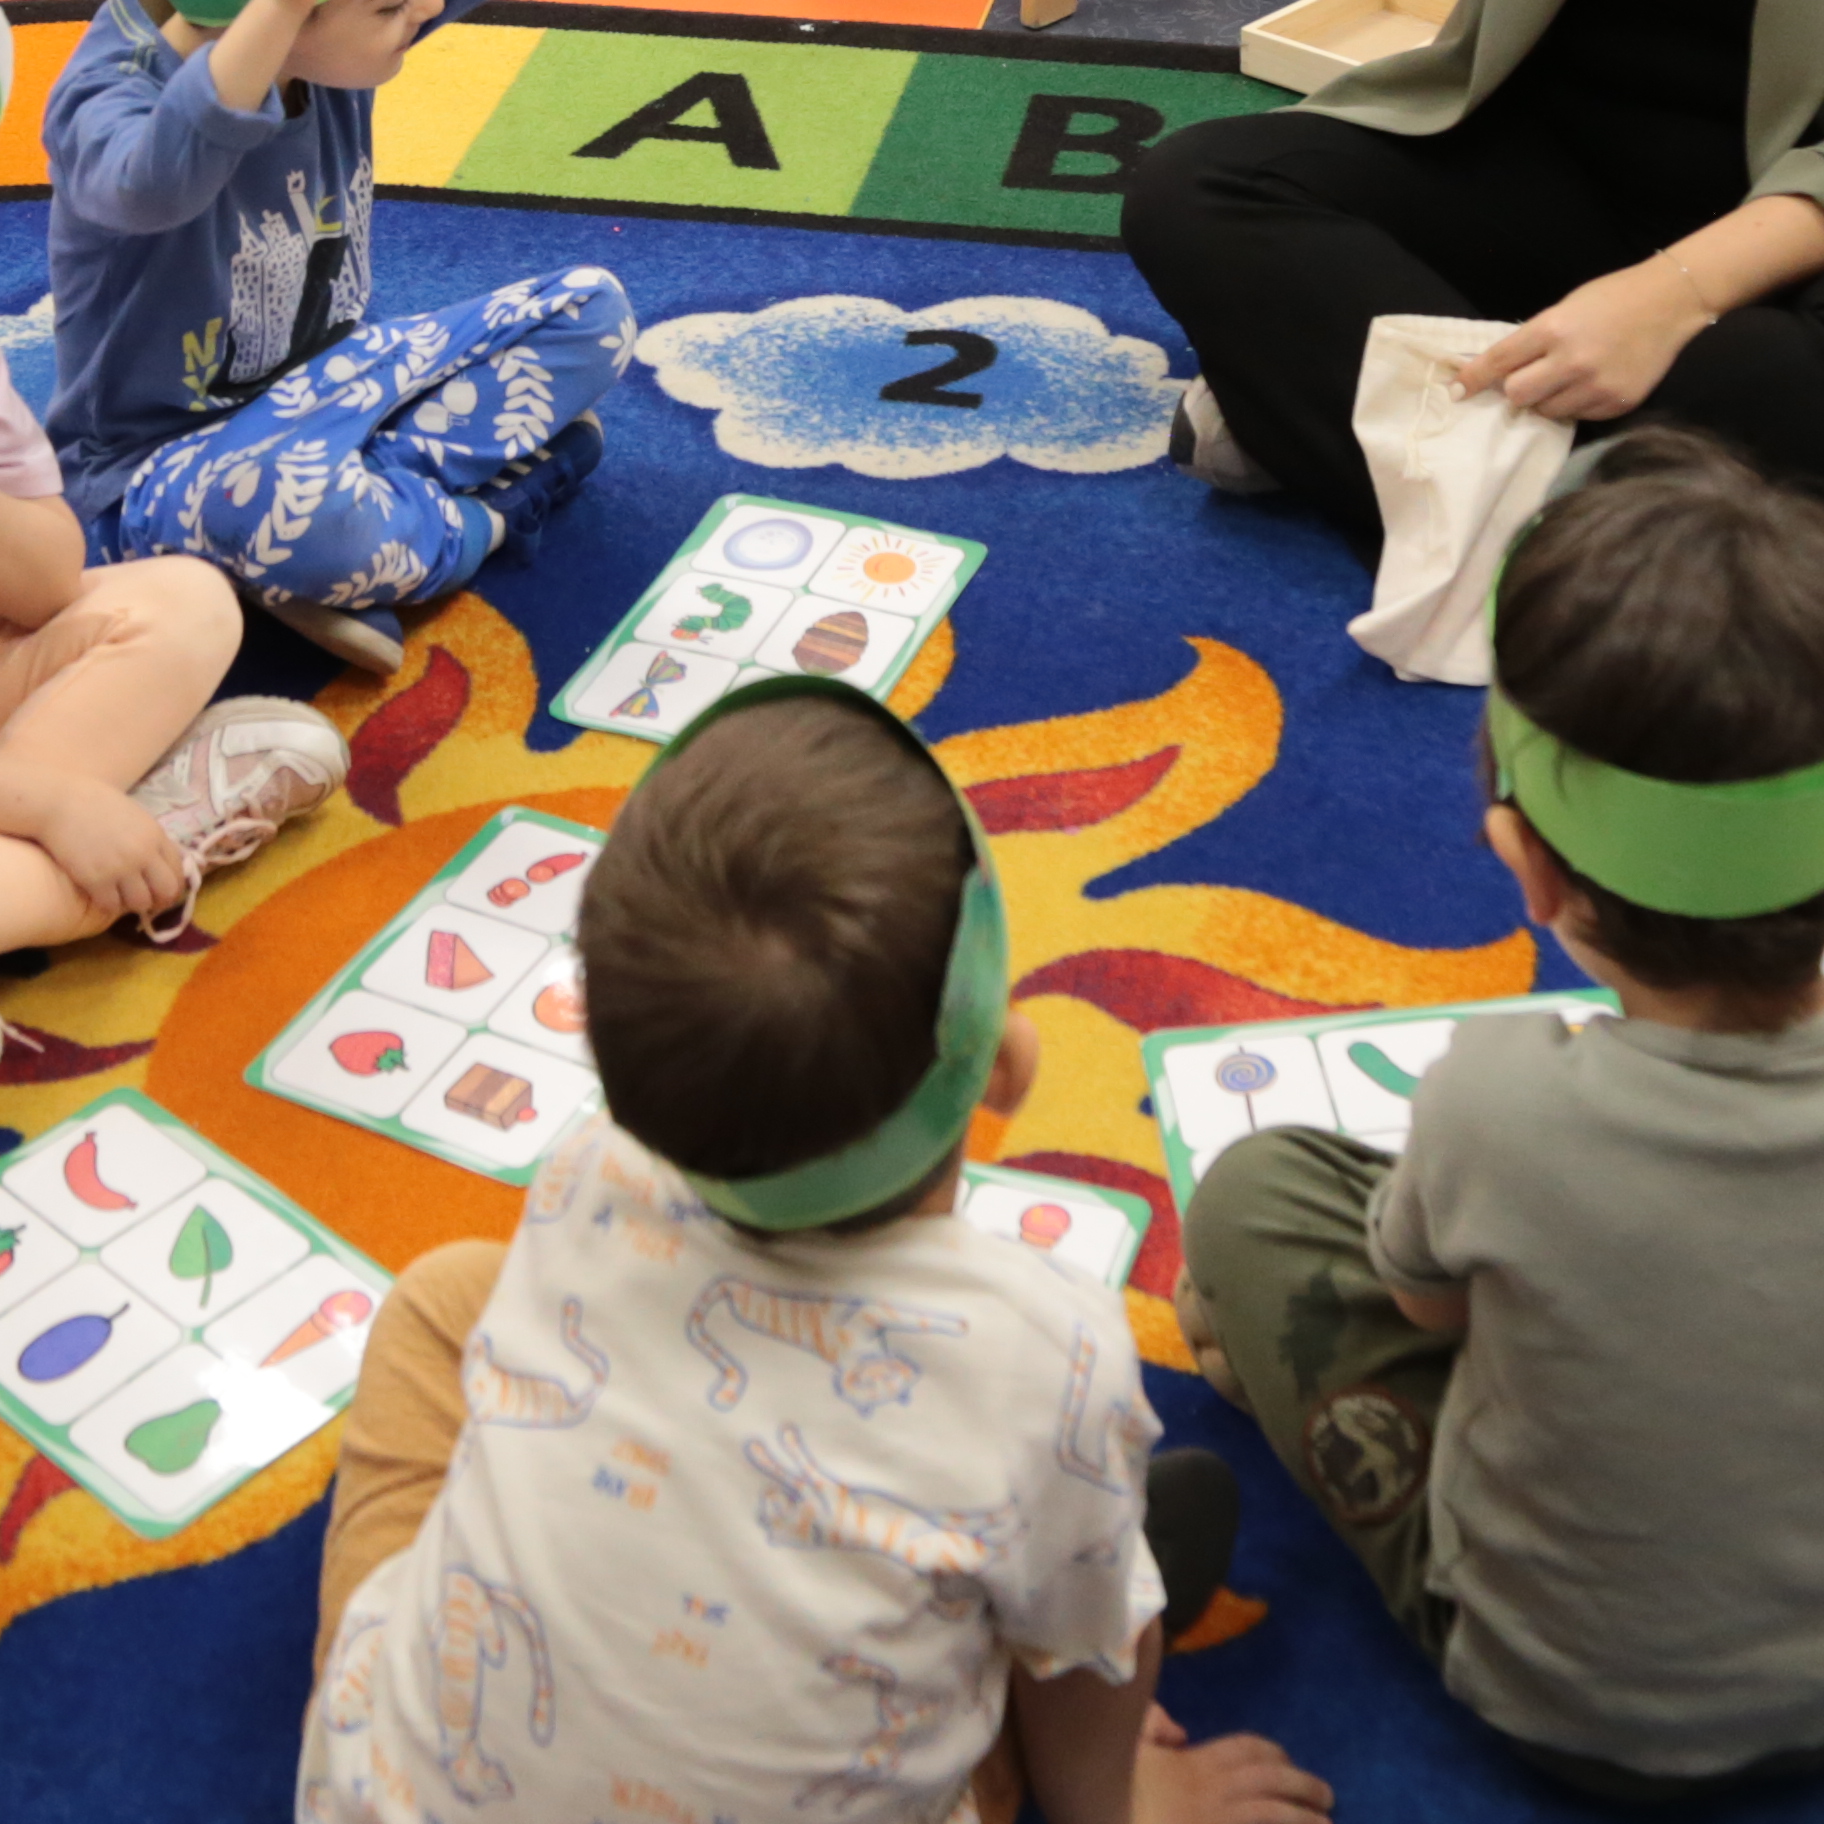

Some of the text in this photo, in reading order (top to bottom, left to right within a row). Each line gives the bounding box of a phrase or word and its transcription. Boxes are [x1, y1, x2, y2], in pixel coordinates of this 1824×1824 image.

[572, 69, 782, 172] A
[1002, 92, 1161, 191] B
[880, 327, 999, 411] 2
